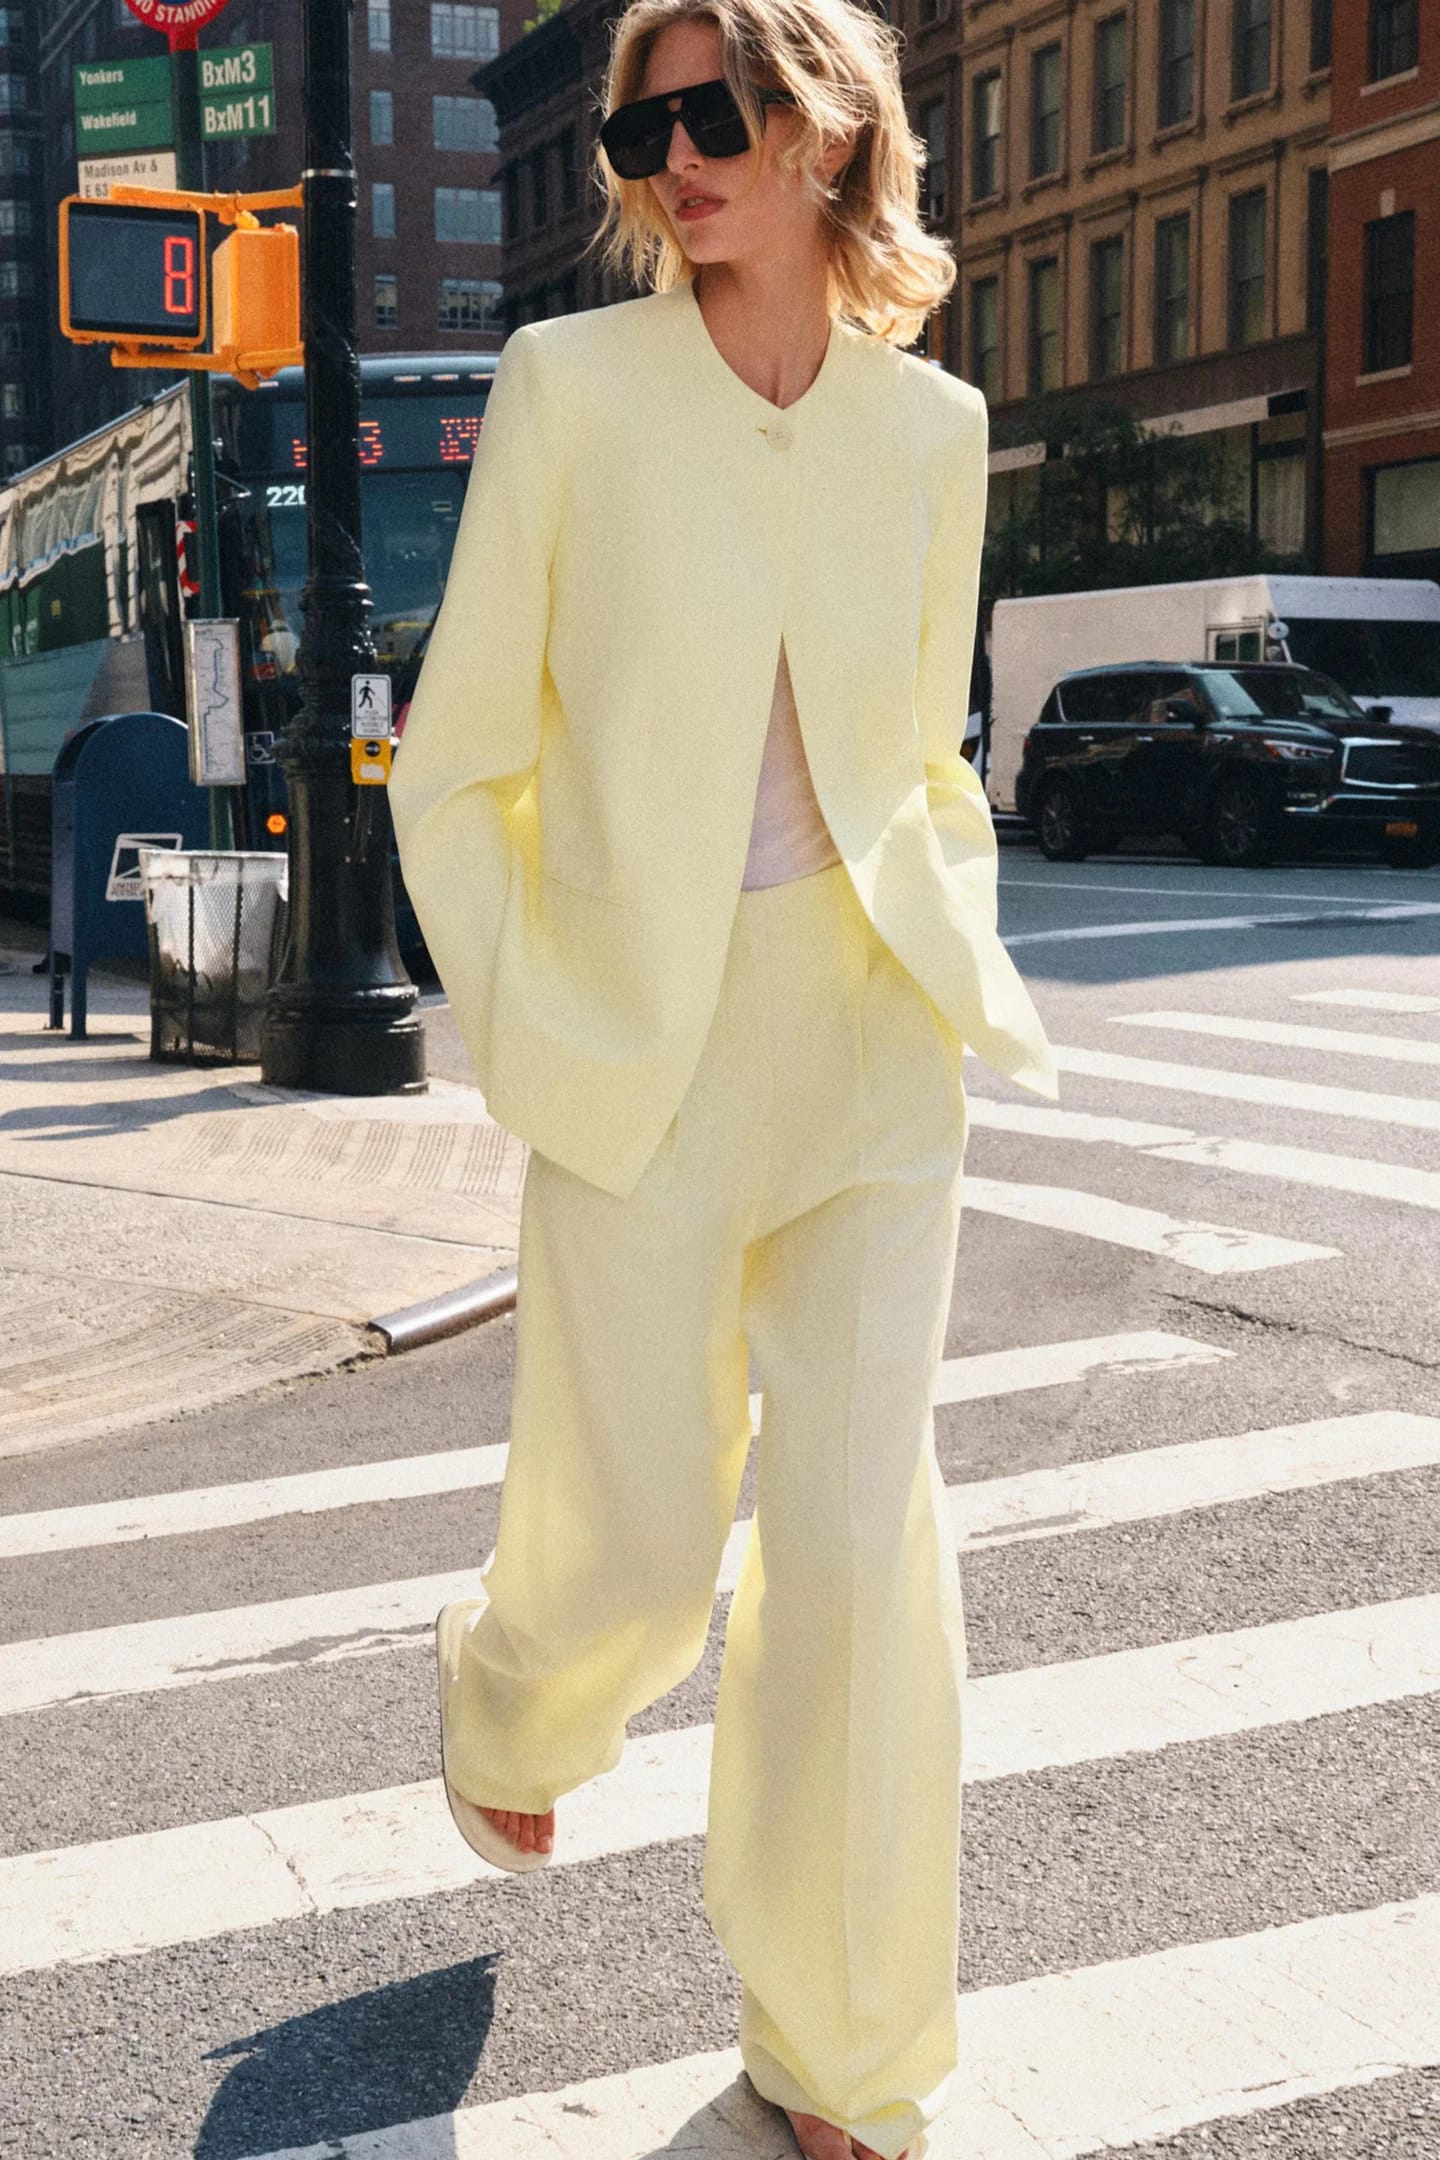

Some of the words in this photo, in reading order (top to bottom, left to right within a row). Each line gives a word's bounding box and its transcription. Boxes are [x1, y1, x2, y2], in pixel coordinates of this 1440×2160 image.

[135, 0, 154, 14] O
[155, 0, 217, 24] STANDI
[80, 69, 124, 86] Yonkers
[202, 50, 256, 88] BxM3
[81, 109, 137, 131] Wakefield
[204, 94, 270, 134] BxM11
[83, 163, 129, 179] Madison
[132, 160, 146, 175] Av
[150, 159, 158, 173] &
[85, 184, 91, 198] E
[95, 182, 108, 198] 63
[164, 236, 194, 315] 8
